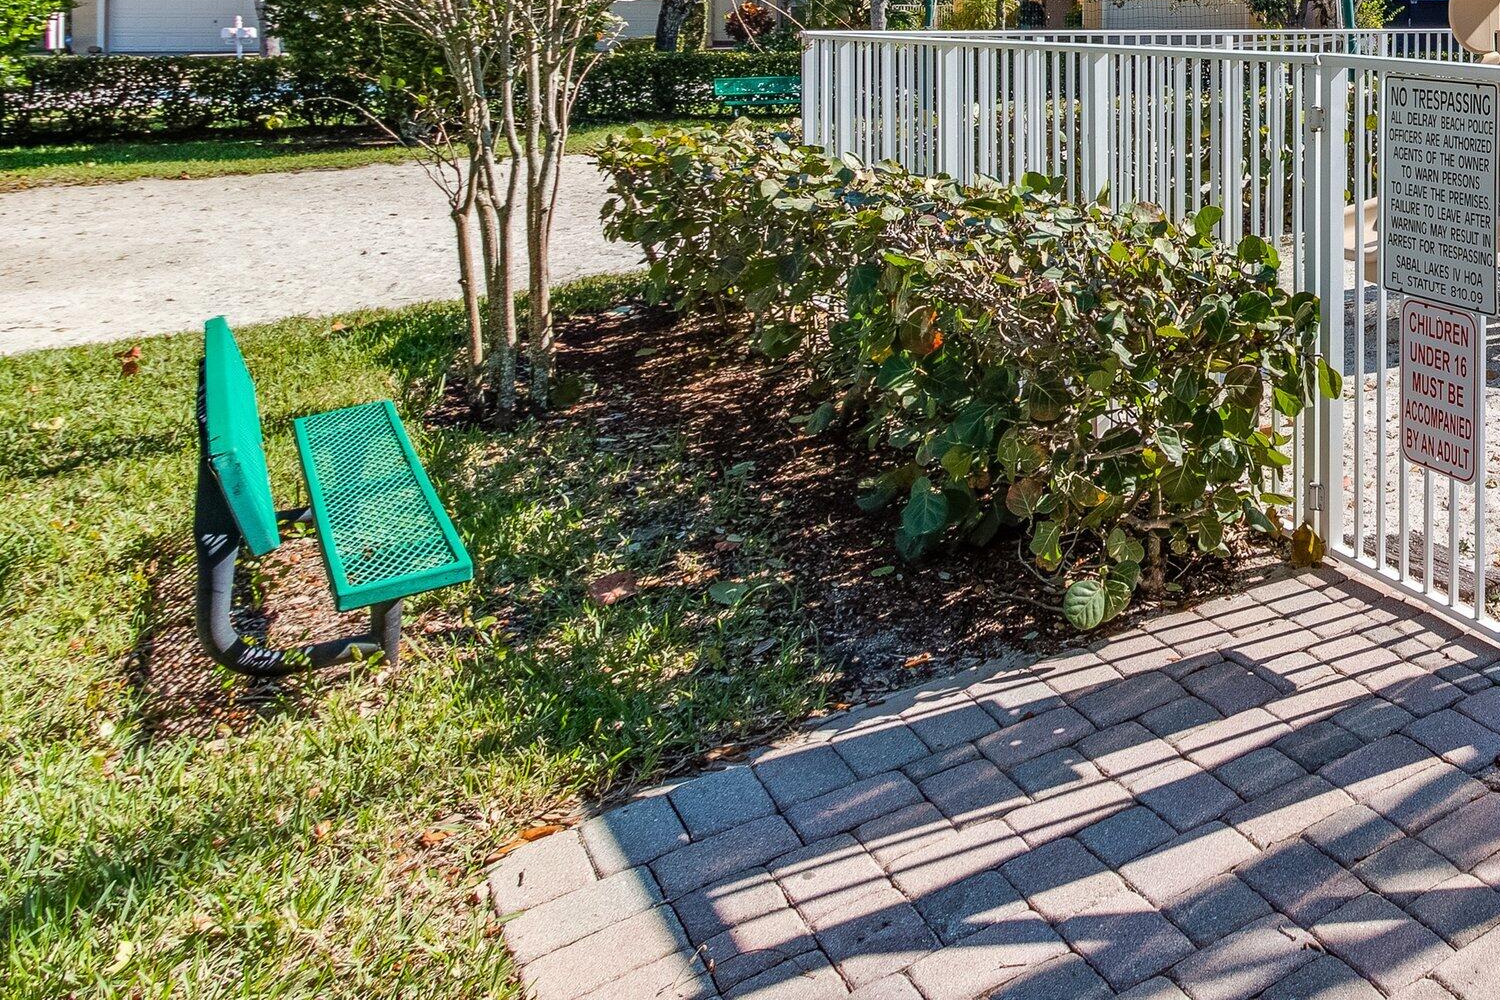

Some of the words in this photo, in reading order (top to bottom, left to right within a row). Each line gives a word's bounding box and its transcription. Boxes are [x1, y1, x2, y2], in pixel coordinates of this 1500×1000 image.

[1391, 87, 1407, 107] NO
[1413, 89, 1491, 115] TRESPASSING
[1391, 111, 1402, 124] ALL
[1408, 113, 1437, 127] DELRAY
[1441, 116, 1465, 132] BEACH
[1468, 120, 1493, 135] POLICE
[1389, 129, 1422, 144] OFFICERS
[1425, 134, 1440, 147] ARE
[1443, 136, 1491, 153] AUTHORIZED
[1393, 147, 1422, 162] AGENTS
[1426, 151, 1437, 164] OF
[1440, 153, 1455, 167] THE
[1459, 155, 1489, 172] OWNER
[1401, 165, 1412, 178] TO
[1415, 167, 1439, 183] WARN
[1443, 170, 1480, 189] PERSONS
[1392, 181, 1402, 194] TO
[1405, 183, 1427, 200] LEAVE
[1431, 187, 1445, 202] THE
[1449, 190, 1491, 210] PREMISES.
[1391, 199, 1421, 216] FAILURE
[1424, 204, 1434, 218] TO
[1438, 207, 1461, 223] LEAVE
[1465, 212, 1491, 229] AFTER
[1391, 216, 1427, 236] WARNING
[1430, 221, 1447, 238] MAY
[1451, 228, 1479, 245] RESULT
[1483, 234, 1491, 248] IN
[1388, 233, 1416, 250] ARREST
[1419, 238, 1436, 253] FOR
[1439, 242, 1495, 268] TRESPASSING.
[1396, 256, 1421, 274] SABAL
[1424, 261, 1449, 280] LAKES
[1453, 267, 1461, 281] IV
[1464, 269, 1483, 286] HOA
[1392, 273, 1403, 285] FL.
[1407, 275, 1446, 296] STATUTE
[1451, 285, 1483, 303] 810.09
[1410, 312, 1468, 348] CHILDREN
[1410, 341, 1450, 373] UNDER
[1455, 356, 1466, 377] 16
[1412, 371, 1444, 401] MUST
[1448, 381, 1463, 407] BE
[1405, 399, 1471, 440] ACCOMPANIED
[1407, 428, 1419, 449] BY
[1421, 434, 1434, 459] AN
[1437, 440, 1469, 469] ADULT
